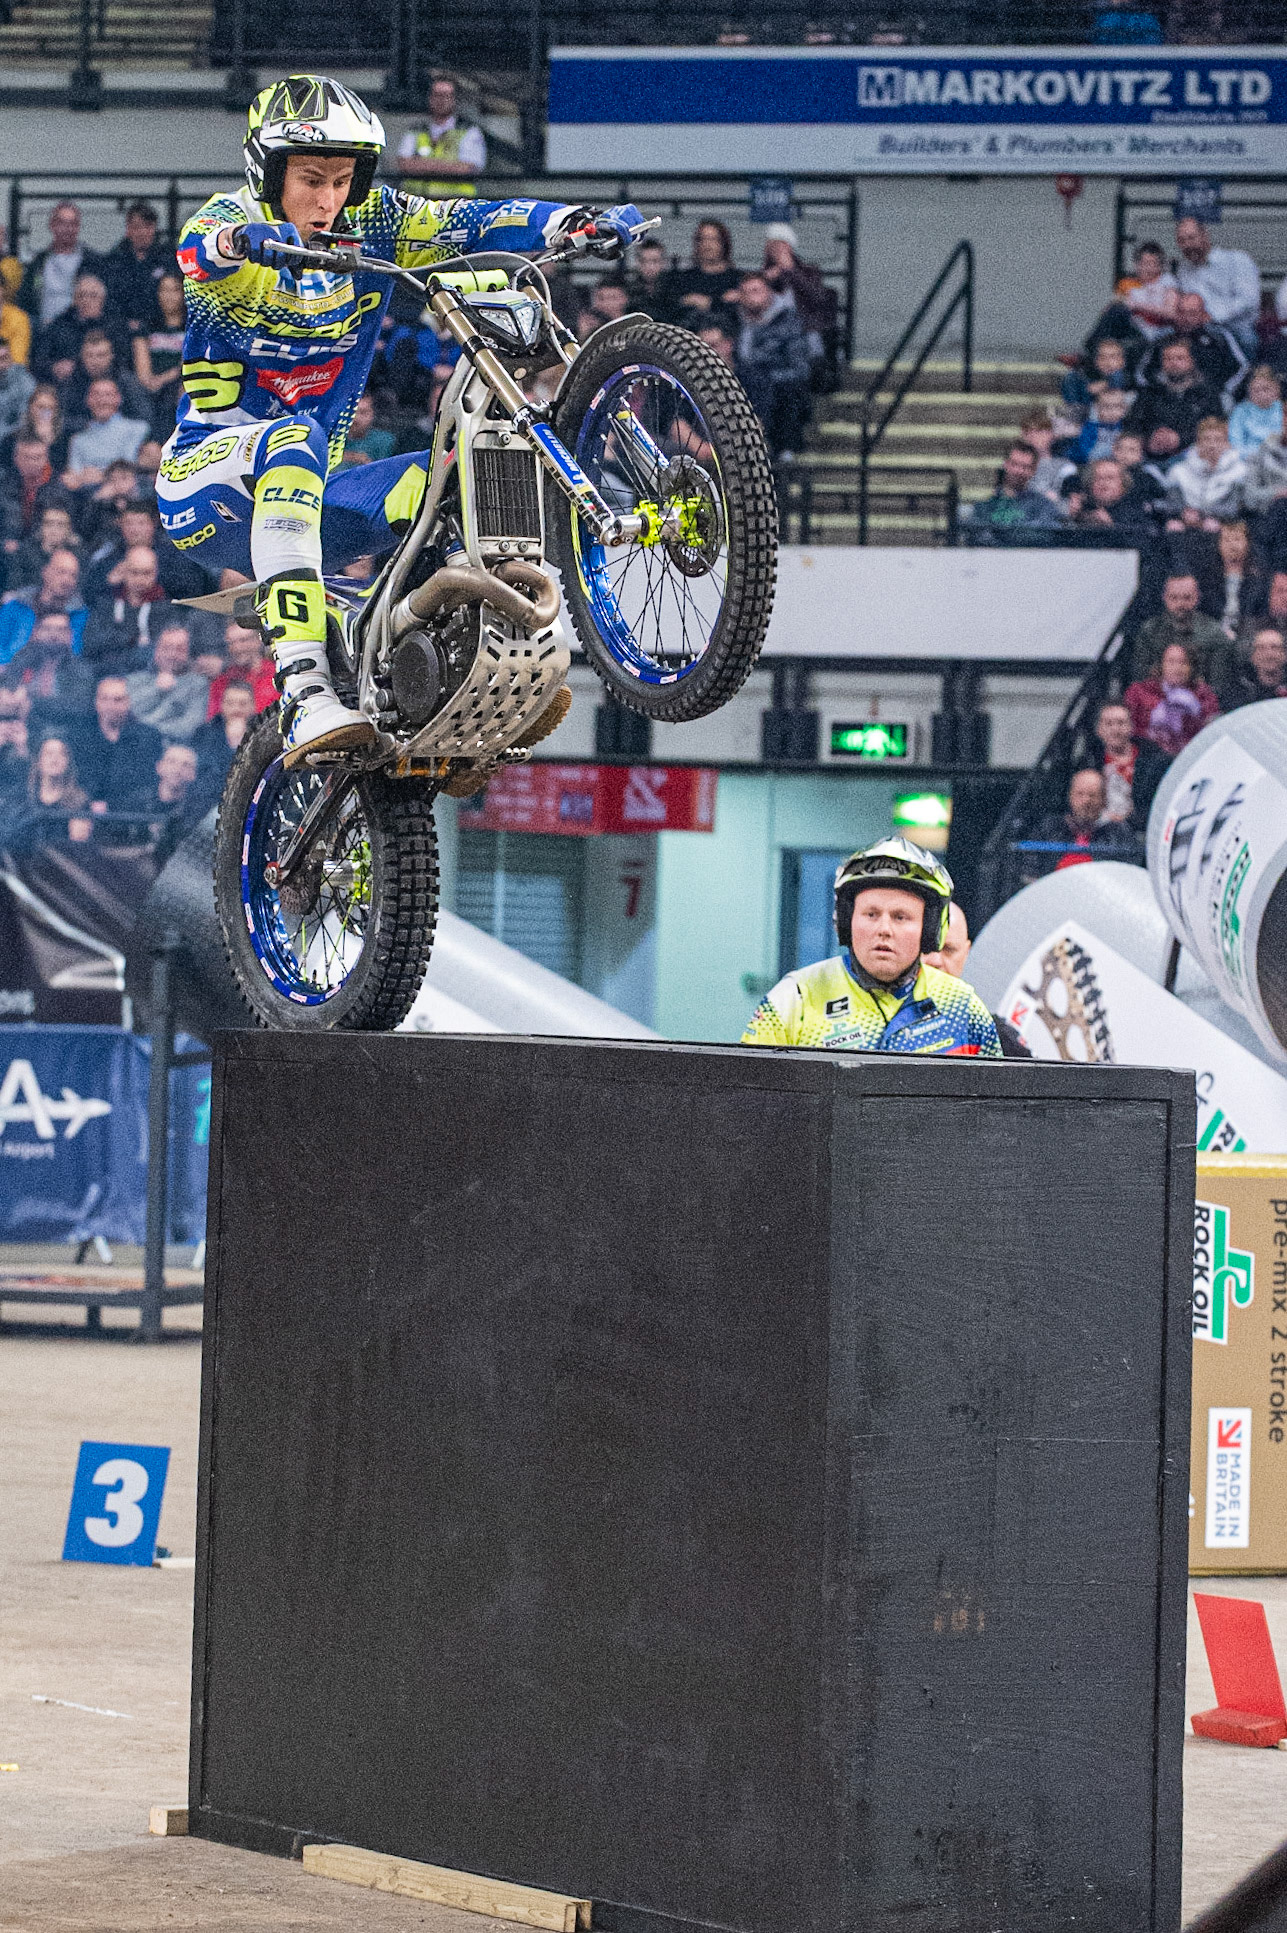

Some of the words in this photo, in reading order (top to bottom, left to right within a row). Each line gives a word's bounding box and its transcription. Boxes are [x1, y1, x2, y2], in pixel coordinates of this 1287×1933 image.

[904, 70, 1172, 105] MARKOVITZ
[1184, 70, 1272, 105] LTD
[1127, 135, 1246, 154] Merchants
[262, 487, 321, 512] CLICE
[825, 1036, 849, 1049] ROCK
[1194, 1206, 1210, 1284] ROCK
[1193, 1289, 1209, 1334] OIL
[1269, 1352, 1287, 1443] stroke
[85, 1458, 150, 1549] 3
[1214, 1453, 1228, 1538] BRITAIN
[1228, 1453, 1241, 1510] MADE
[1228, 1517, 1240, 1537] IN
